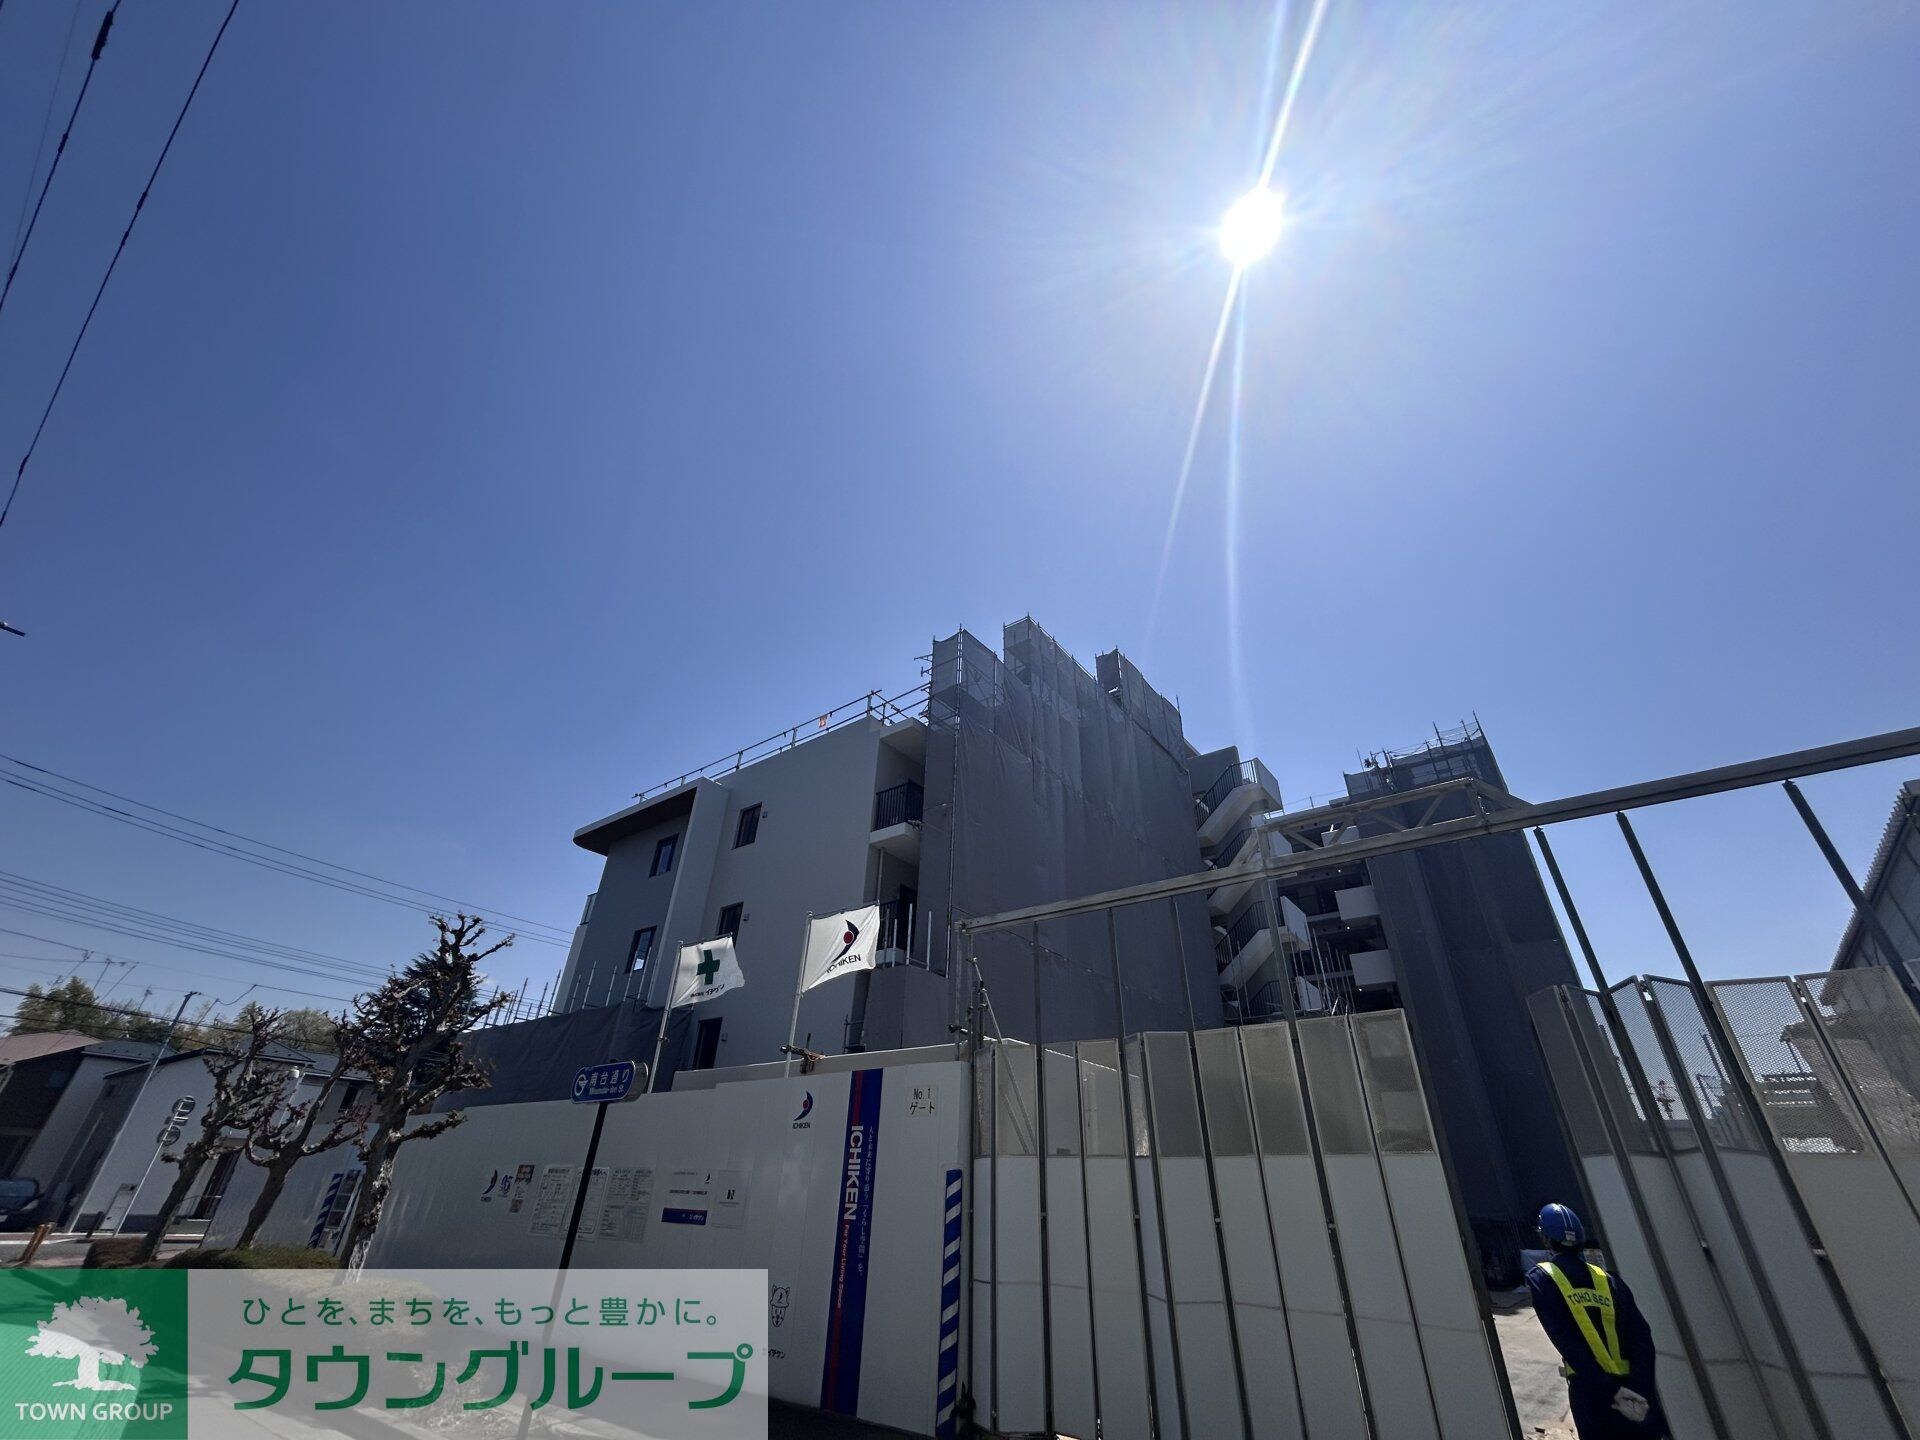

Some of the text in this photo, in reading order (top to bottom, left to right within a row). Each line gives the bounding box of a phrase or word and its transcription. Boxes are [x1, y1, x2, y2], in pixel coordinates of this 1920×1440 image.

[909, 1101, 935, 1115] ゲート
[843, 1125, 864, 1221] ICHIKEN
